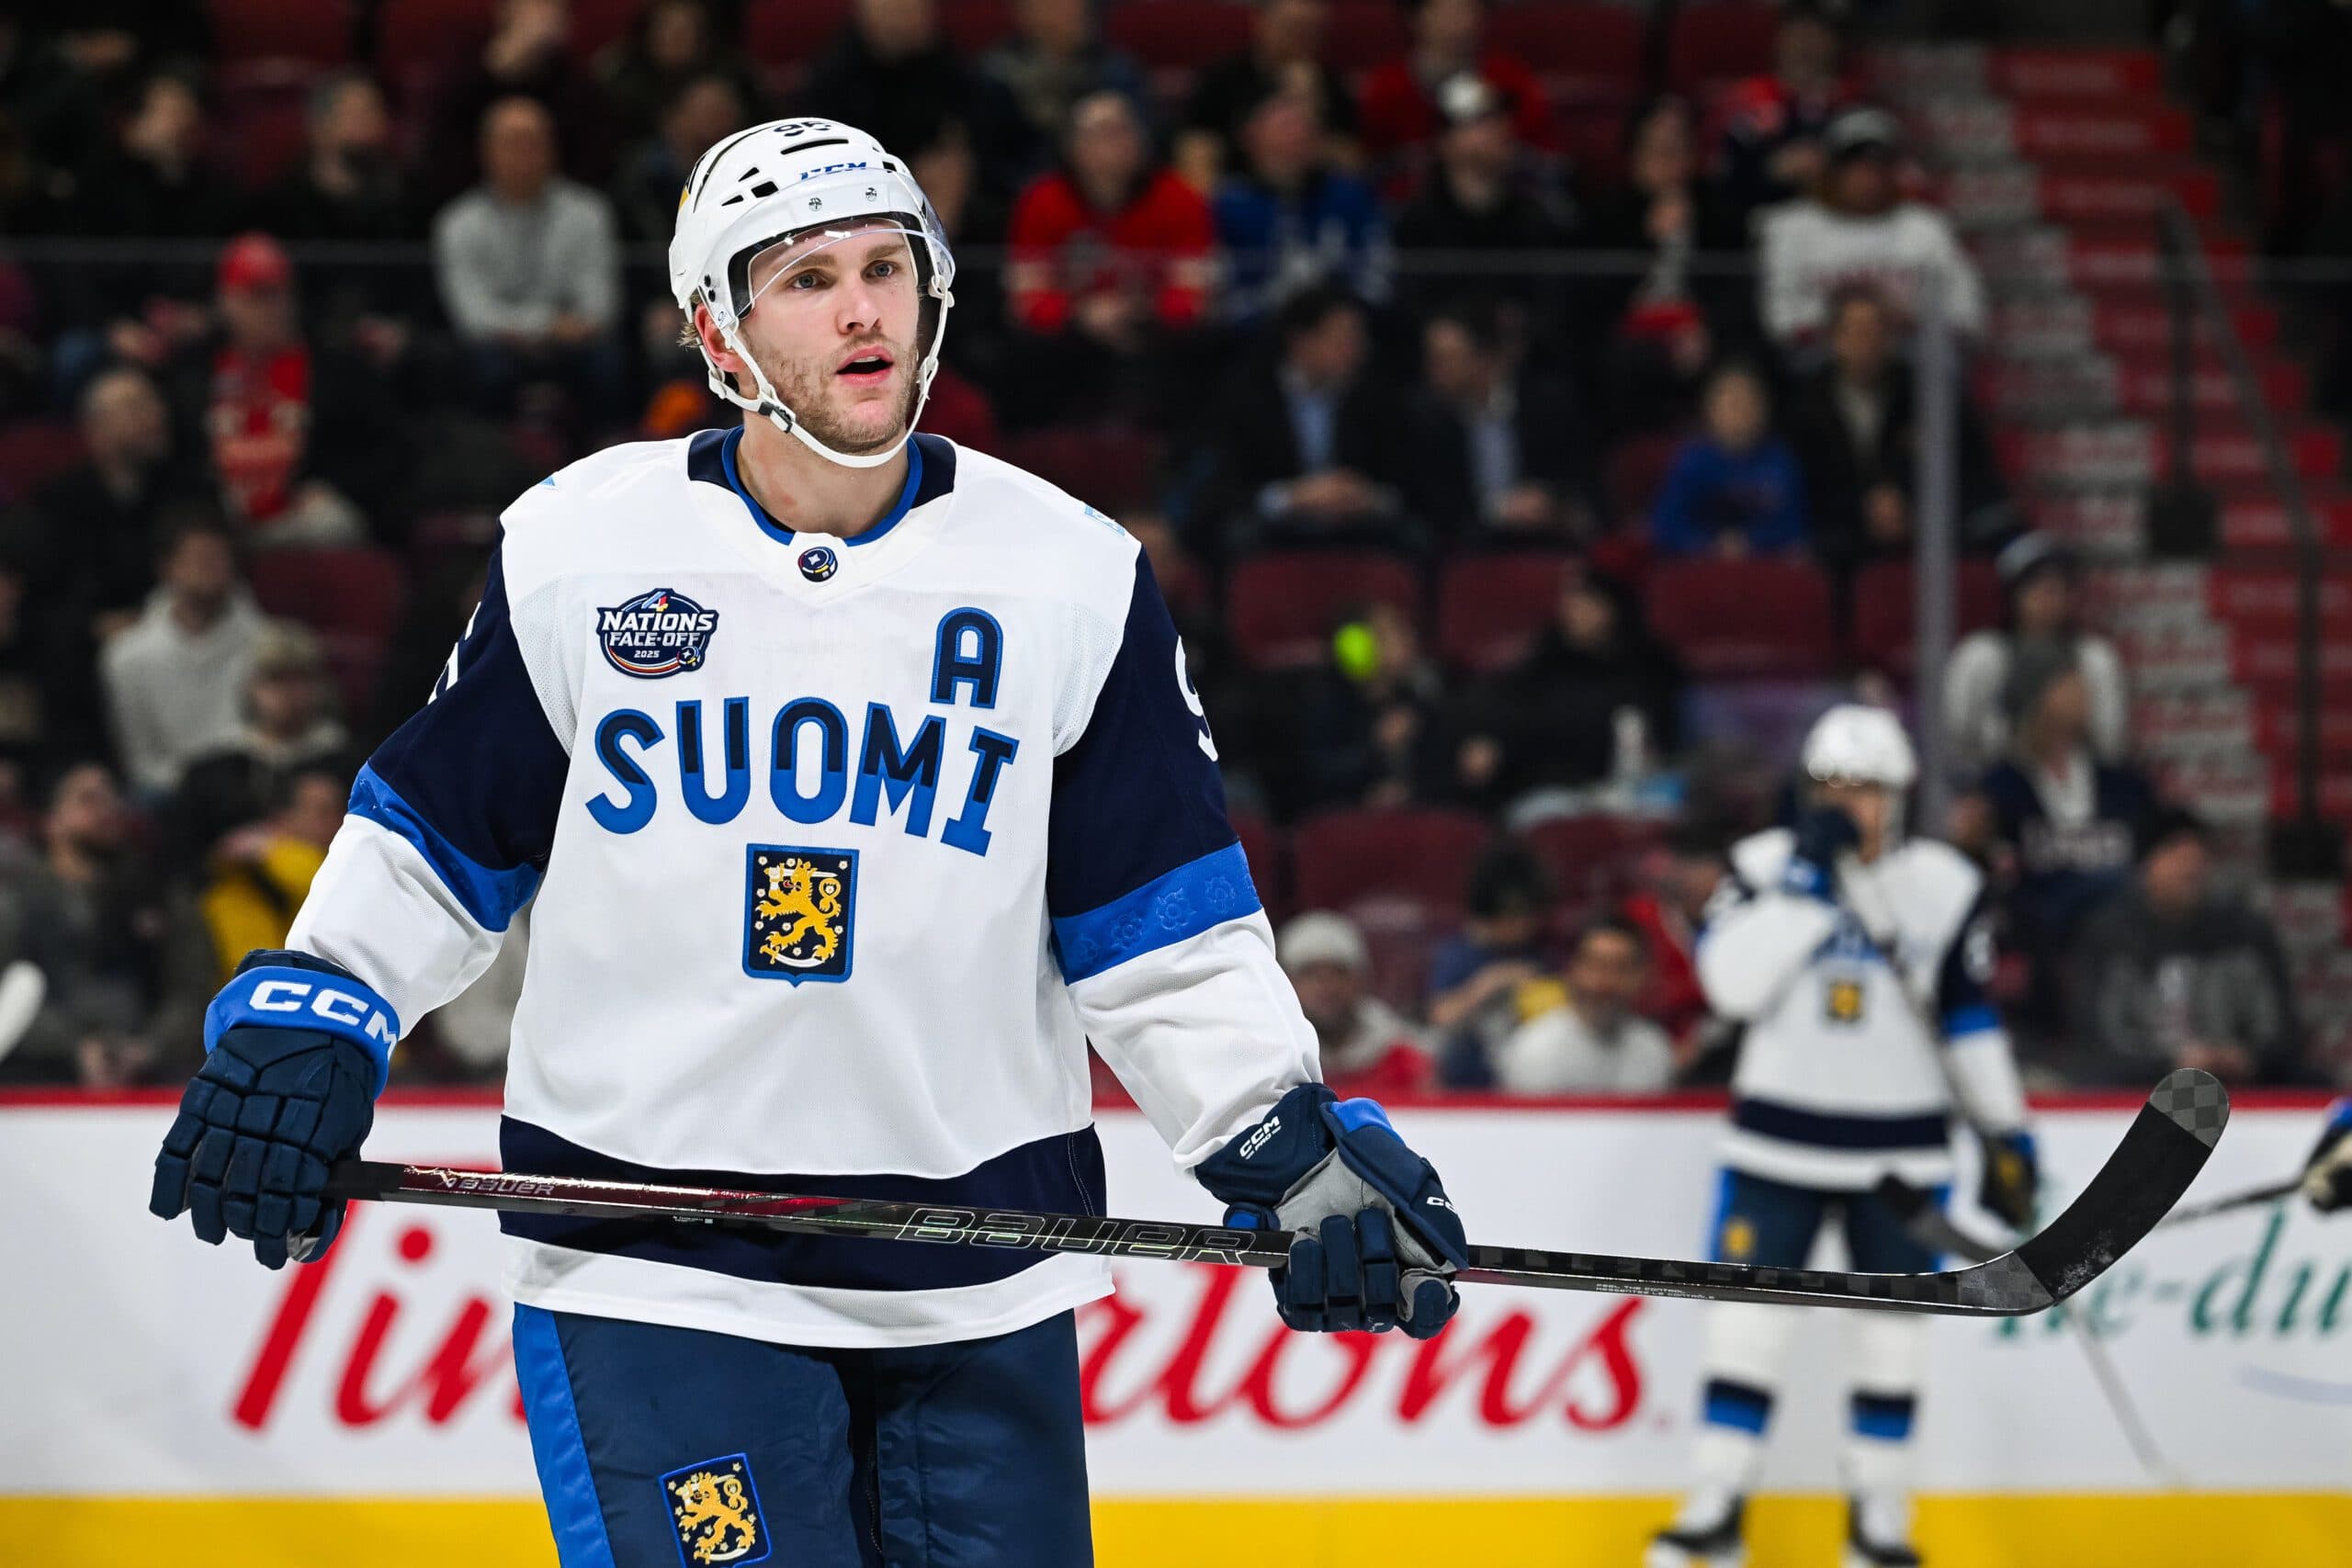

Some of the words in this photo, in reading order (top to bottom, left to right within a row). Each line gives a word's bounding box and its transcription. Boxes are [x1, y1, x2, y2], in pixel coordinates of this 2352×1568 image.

[774, 121, 831, 137] 95
[602, 611, 715, 631] NATIONS
[634, 650, 661, 659] 2025
[930, 606, 1003, 709] A
[585, 695, 1020, 856] SUOMI
[249, 980, 398, 1061] CCM
[1239, 1115, 1281, 1157] CCM
[1255, 1133, 1272, 1151] PRO
[459, 1175, 555, 1196] BAUER
[895, 1207, 1258, 1266] BAUER
